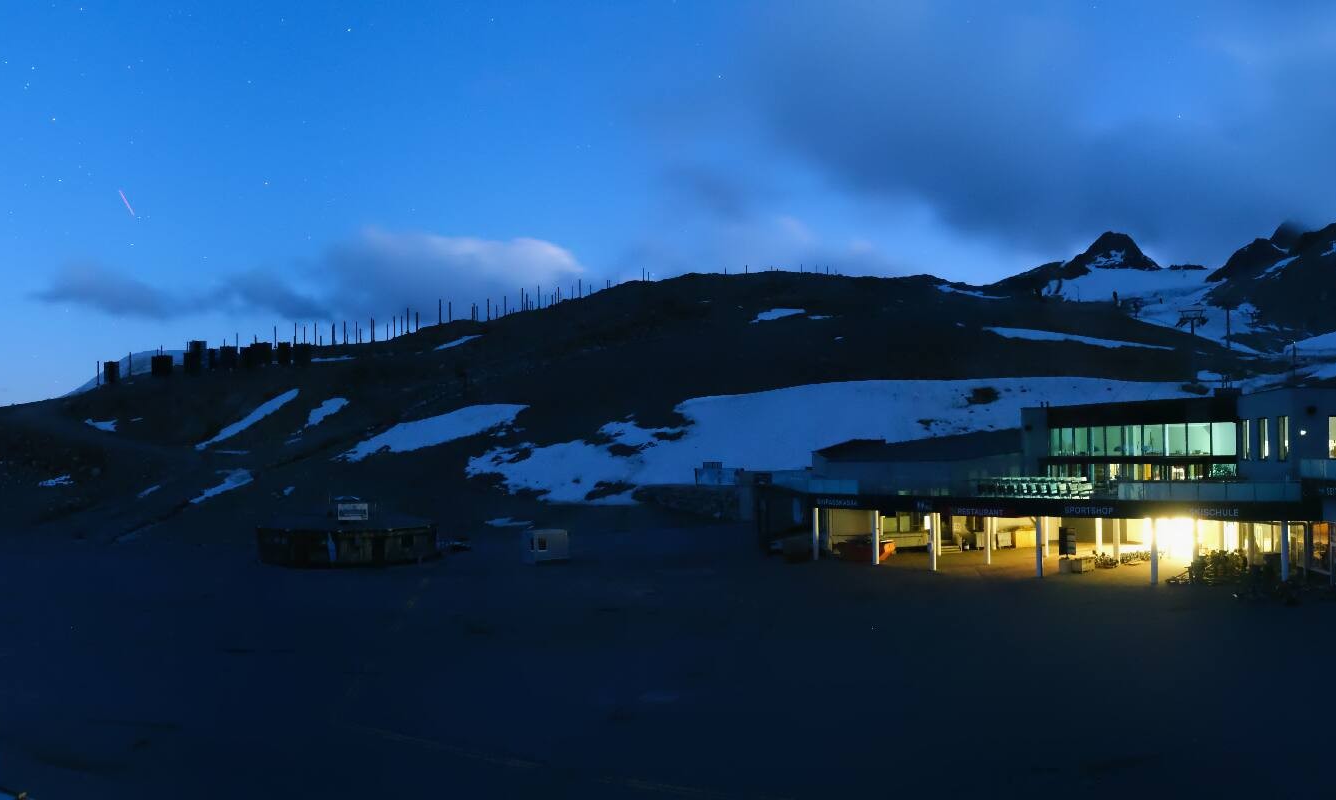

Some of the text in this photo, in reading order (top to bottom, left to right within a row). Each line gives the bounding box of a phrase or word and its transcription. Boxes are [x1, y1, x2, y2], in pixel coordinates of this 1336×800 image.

[957, 507, 1004, 516] RESTAURANT
[1064, 505, 1113, 515] SPORTSHOP
[1190, 507, 1240, 518] SKISCHULE
